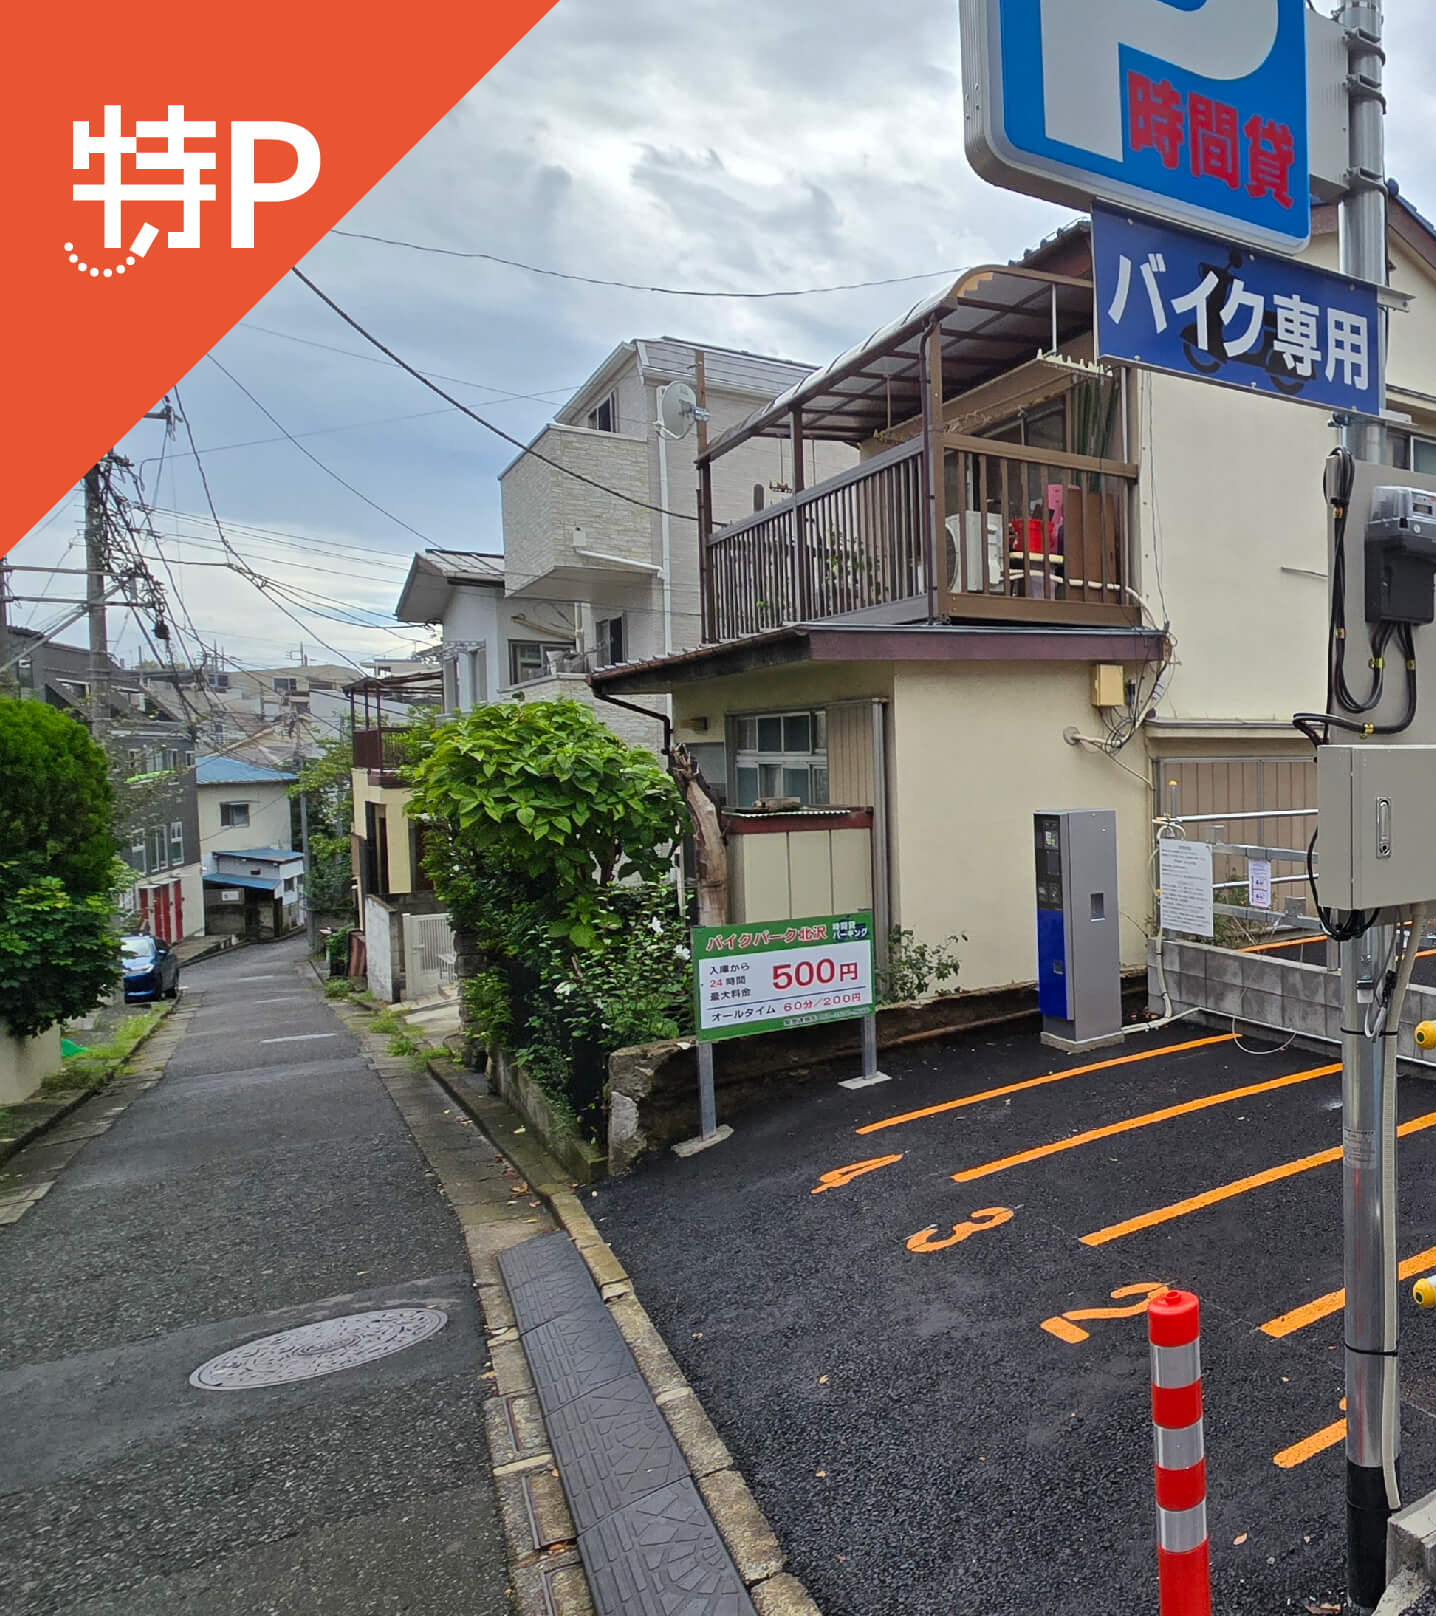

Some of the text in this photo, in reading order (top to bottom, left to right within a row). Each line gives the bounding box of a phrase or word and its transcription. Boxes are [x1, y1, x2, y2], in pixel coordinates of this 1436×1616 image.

[1040, 0, 1280, 163] P
[1126, 70, 1295, 209] 時間貸
[1107, 253, 1370, 391] バイク専用
[706, 925, 828, 952] バイクパーク北沢
[709, 963, 750, 975] 入庫から
[772, 959, 858, 990] 500円
[710, 989, 751, 1001] 最大料金
[811, 1154, 903, 1194] 4
[905, 1206, 1014, 1253] 3
[1040, 1282, 1171, 1345] 2
